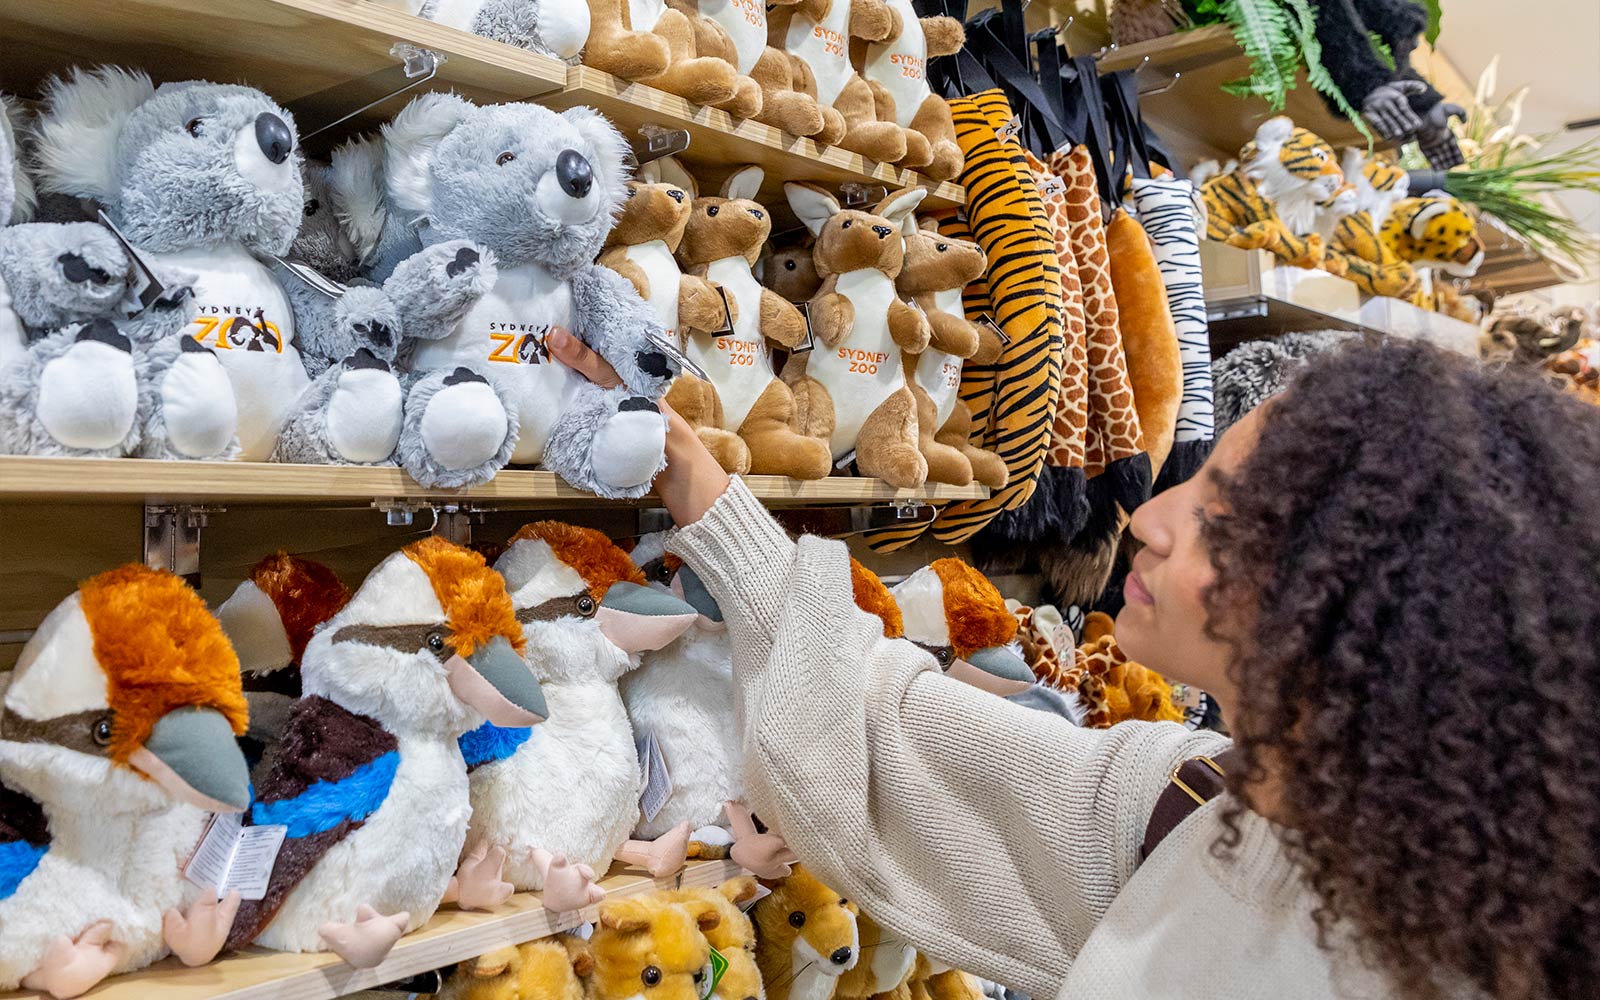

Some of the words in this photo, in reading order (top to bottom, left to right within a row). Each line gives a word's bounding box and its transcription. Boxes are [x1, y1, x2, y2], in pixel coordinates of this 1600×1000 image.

[902, 66, 921, 80] ZOO
[198, 306, 252, 316] YDNEY
[489, 322, 542, 333] SYDNEY
[192, 316, 283, 354] ZOO
[717, 338, 761, 353] SYDNEY
[729, 353, 754, 366] ZOO
[838, 347, 890, 365] SYDNEY
[849, 361, 878, 376] ZOO
